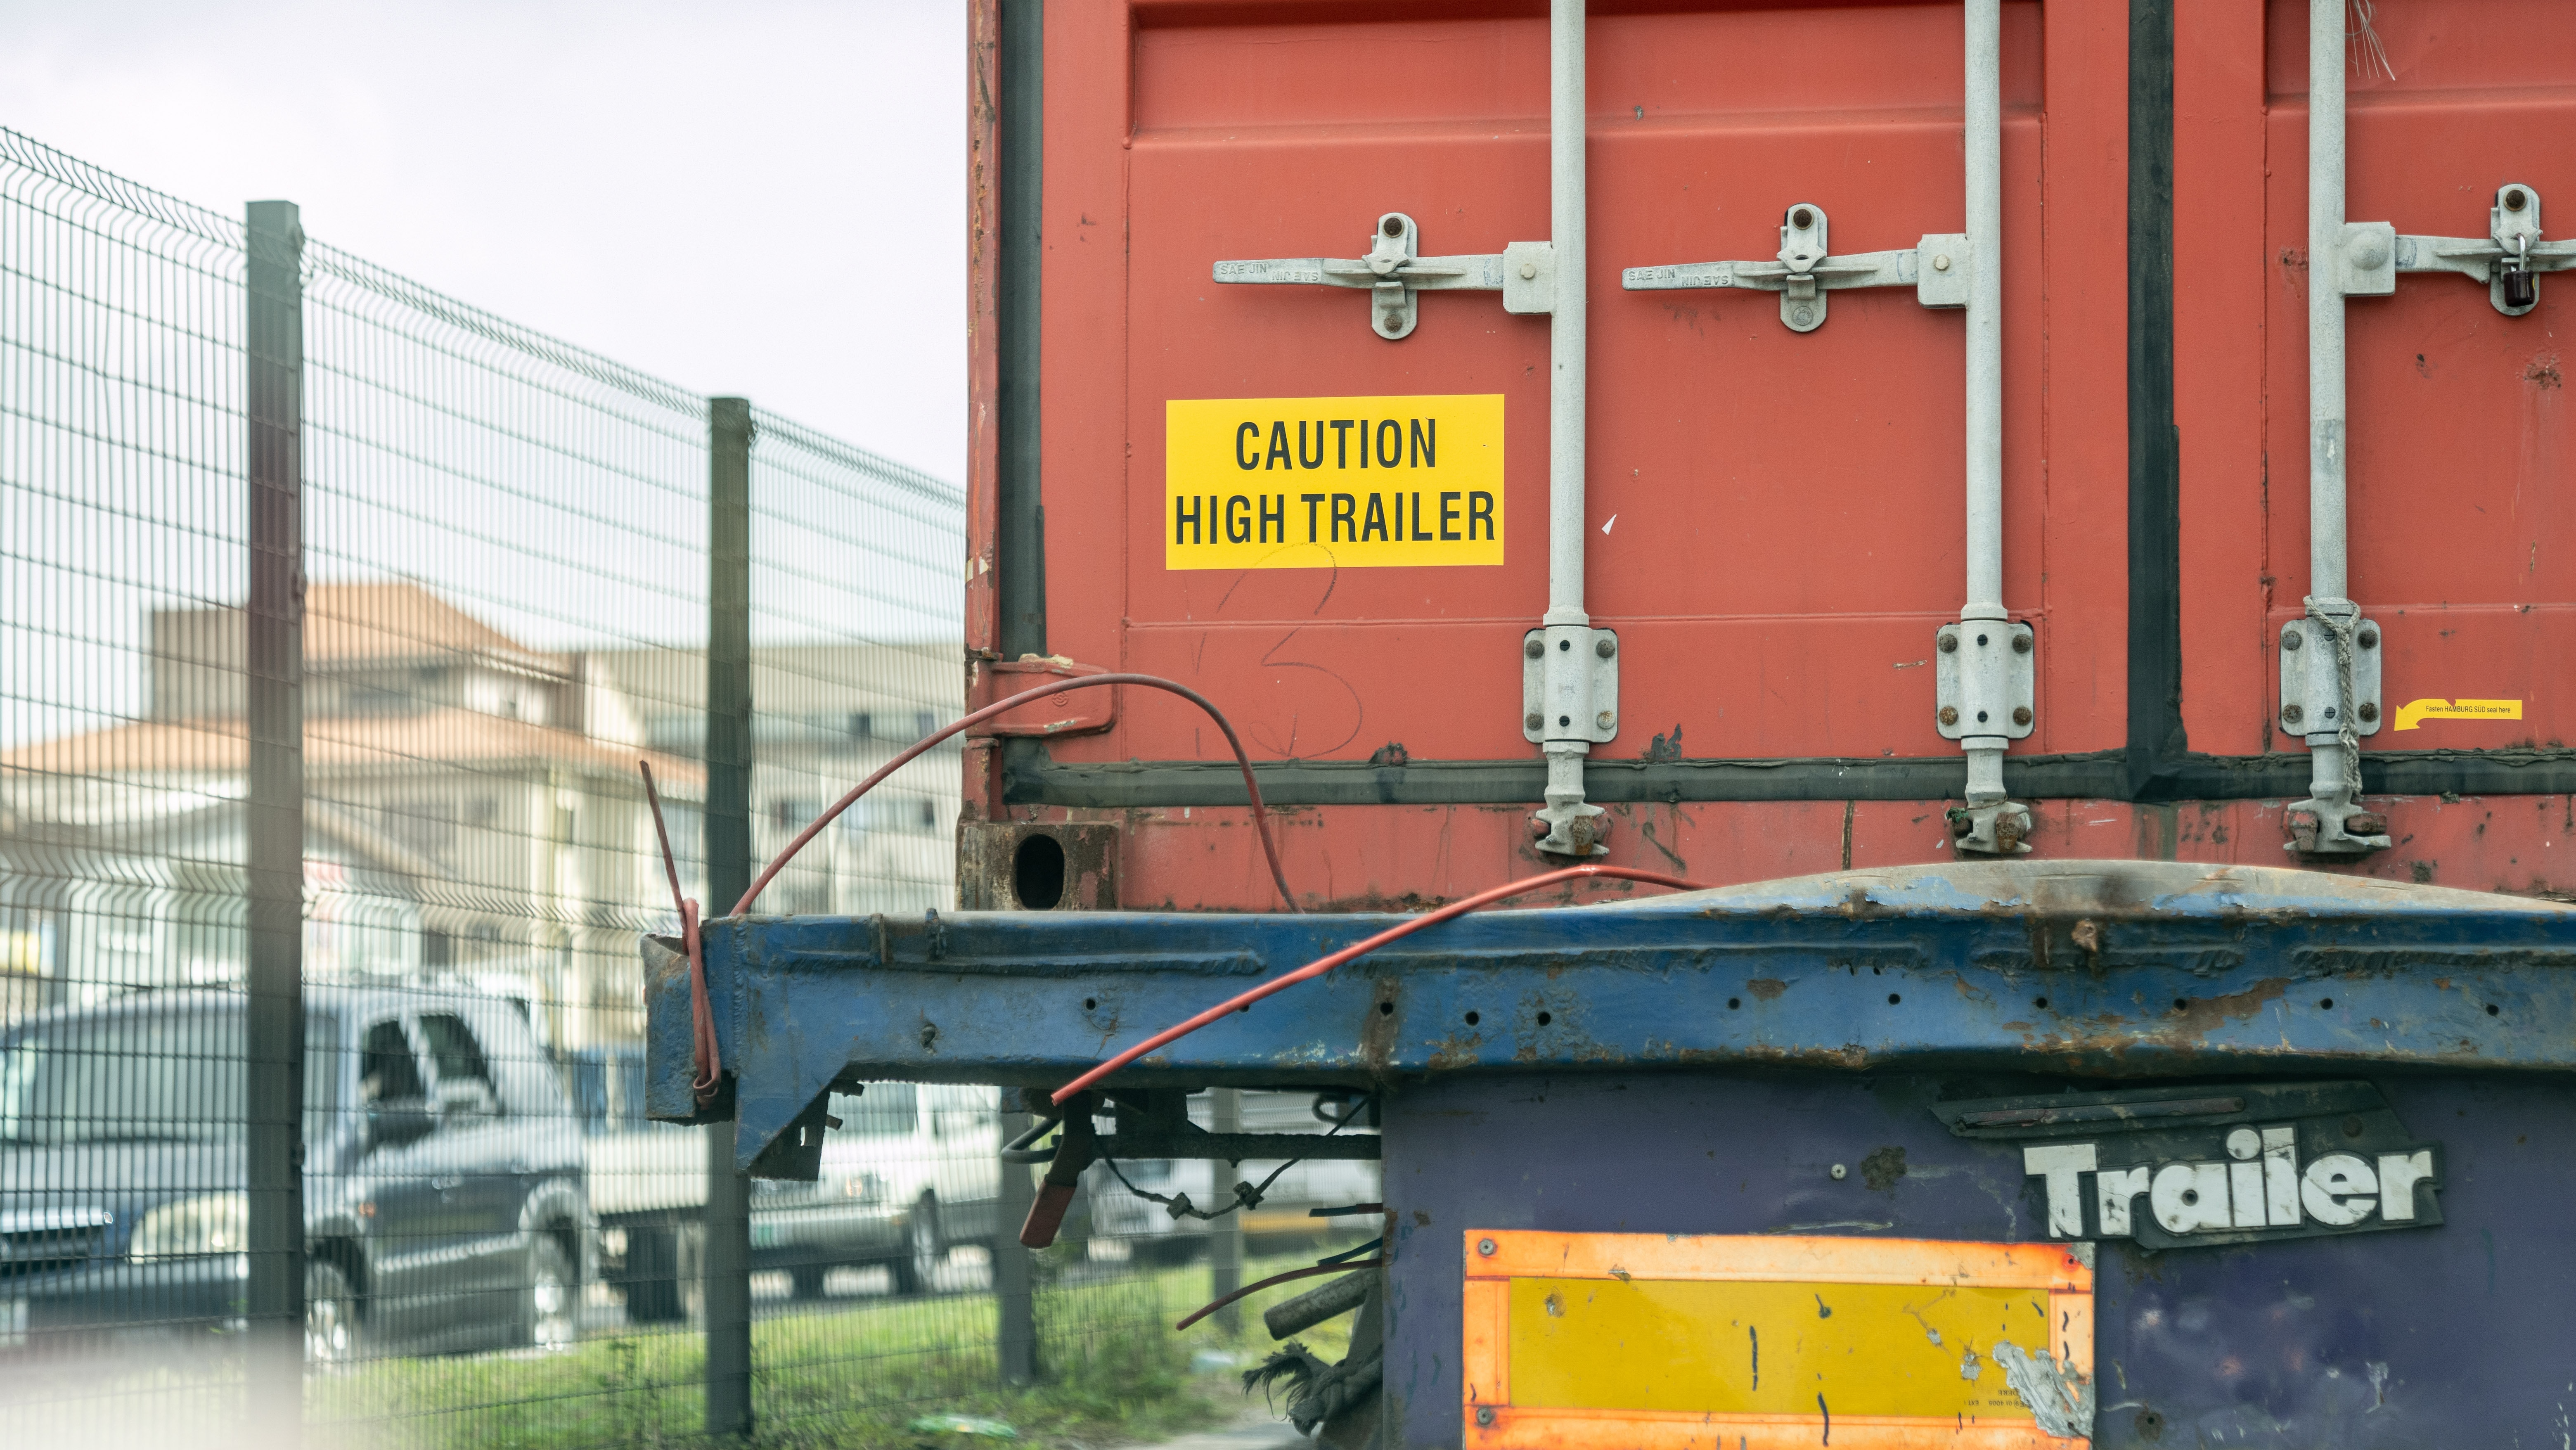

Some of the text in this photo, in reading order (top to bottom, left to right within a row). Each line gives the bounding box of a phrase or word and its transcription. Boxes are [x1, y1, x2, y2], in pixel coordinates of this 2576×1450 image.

[1220, 262, 1268, 275] SAE JIN
[1628, 268, 1676, 281] SAE JIN
[1236, 418, 1436, 471] CAUTION
[1176, 490, 1496, 545] HIGH TRAILER
[2023, 1126, 2434, 1239] Trailer
